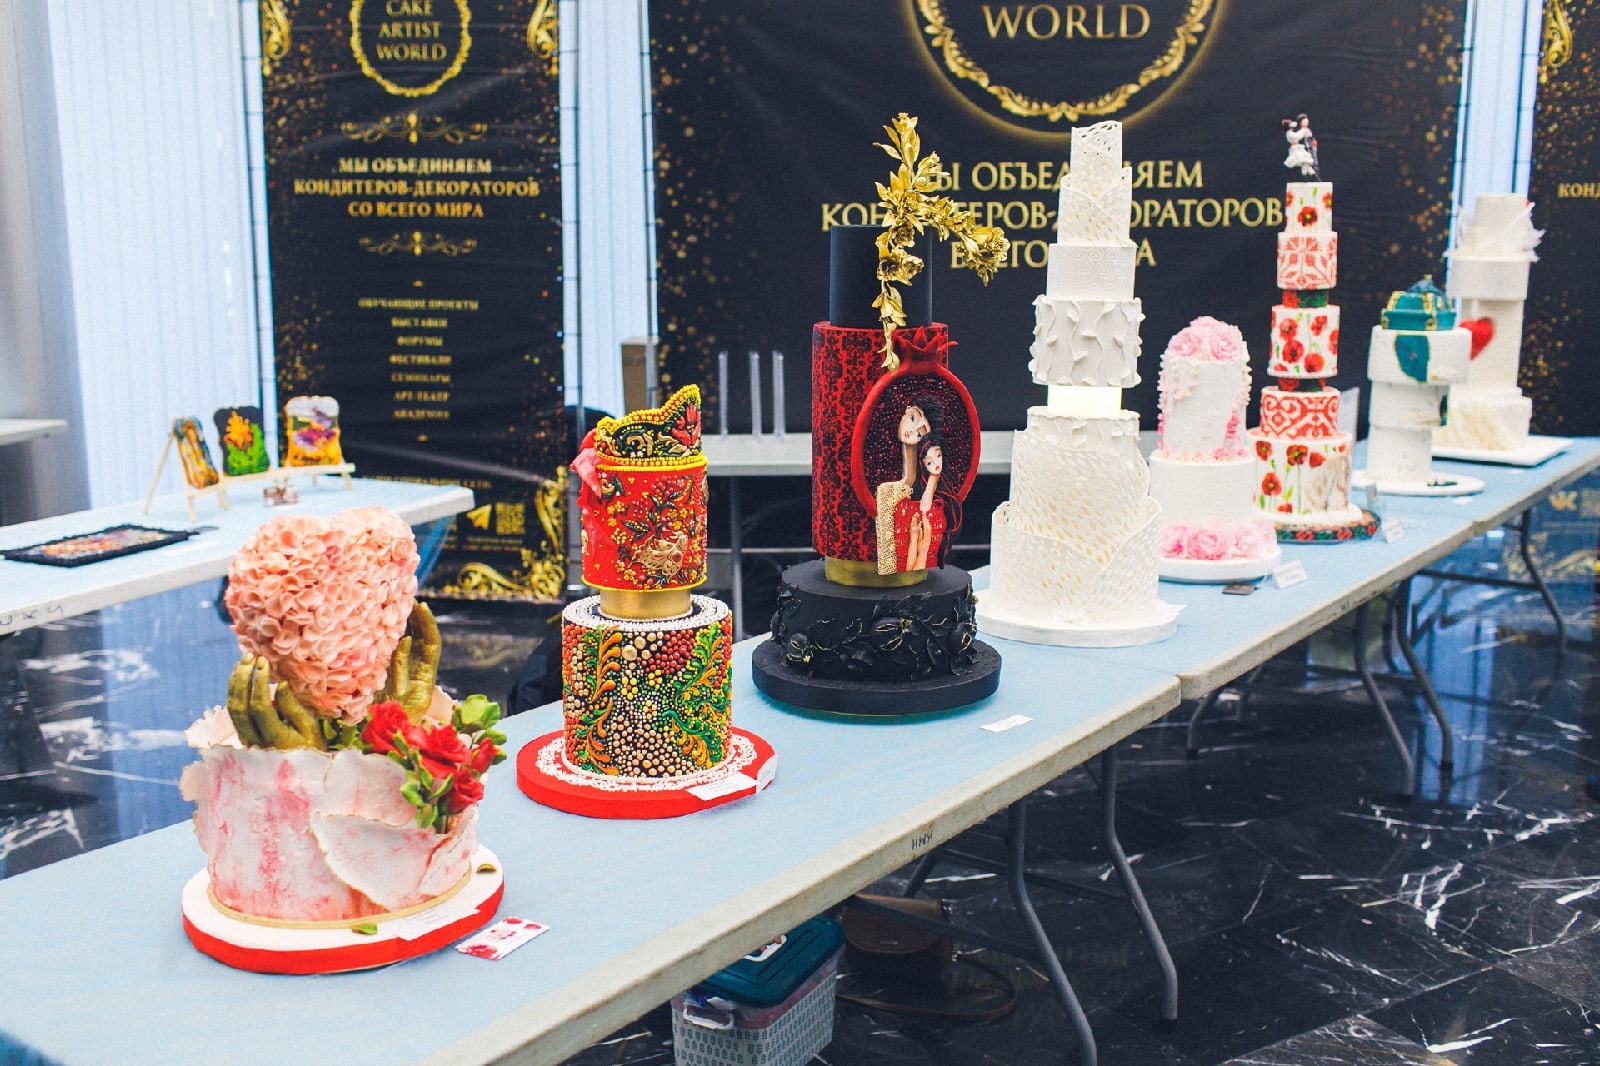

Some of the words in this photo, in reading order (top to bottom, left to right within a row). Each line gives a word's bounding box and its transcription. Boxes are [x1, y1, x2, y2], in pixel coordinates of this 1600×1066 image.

[386, 0, 433, 17] CAKE
[379, 21, 442, 38] ARTIST
[982, 4, 1151, 40] WORLD
[376, 43, 447, 61] WORLD
[338, 157, 369, 174] МЫ
[371, 157, 493, 176] ОБЪЕДИНЯЕМ
[971, 159, 1204, 193] ОБЪЕЯЕМ
[293, 177, 541, 198] КОНДИТЕРОВ-ДЕКОРАТОРОВ
[347, 201, 373, 217] СО
[376, 201, 432, 218] ВСЕГО
[434, 201, 484, 218] МИРА
